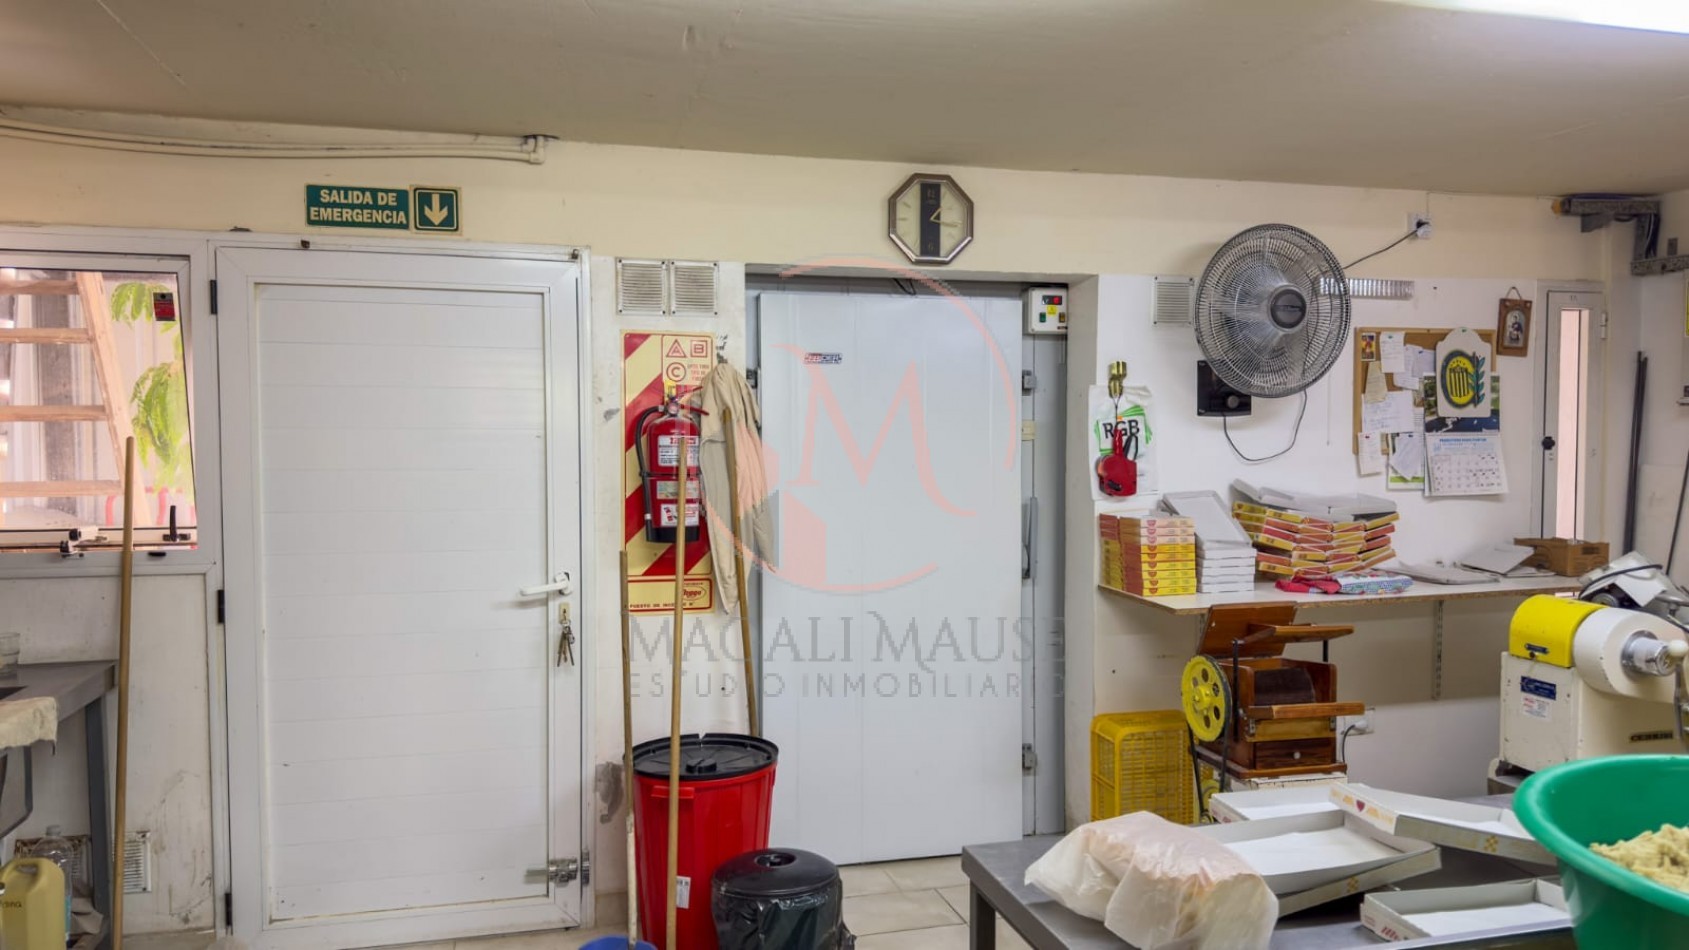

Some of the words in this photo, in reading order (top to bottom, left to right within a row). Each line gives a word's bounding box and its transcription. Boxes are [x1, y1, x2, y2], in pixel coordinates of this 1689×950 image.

[320, 189, 373, 205] SALIDA
[377, 192, 397, 206] DE
[310, 207, 407, 225] EMERGENCIA
[1102, 419, 1140, 439] RGB
